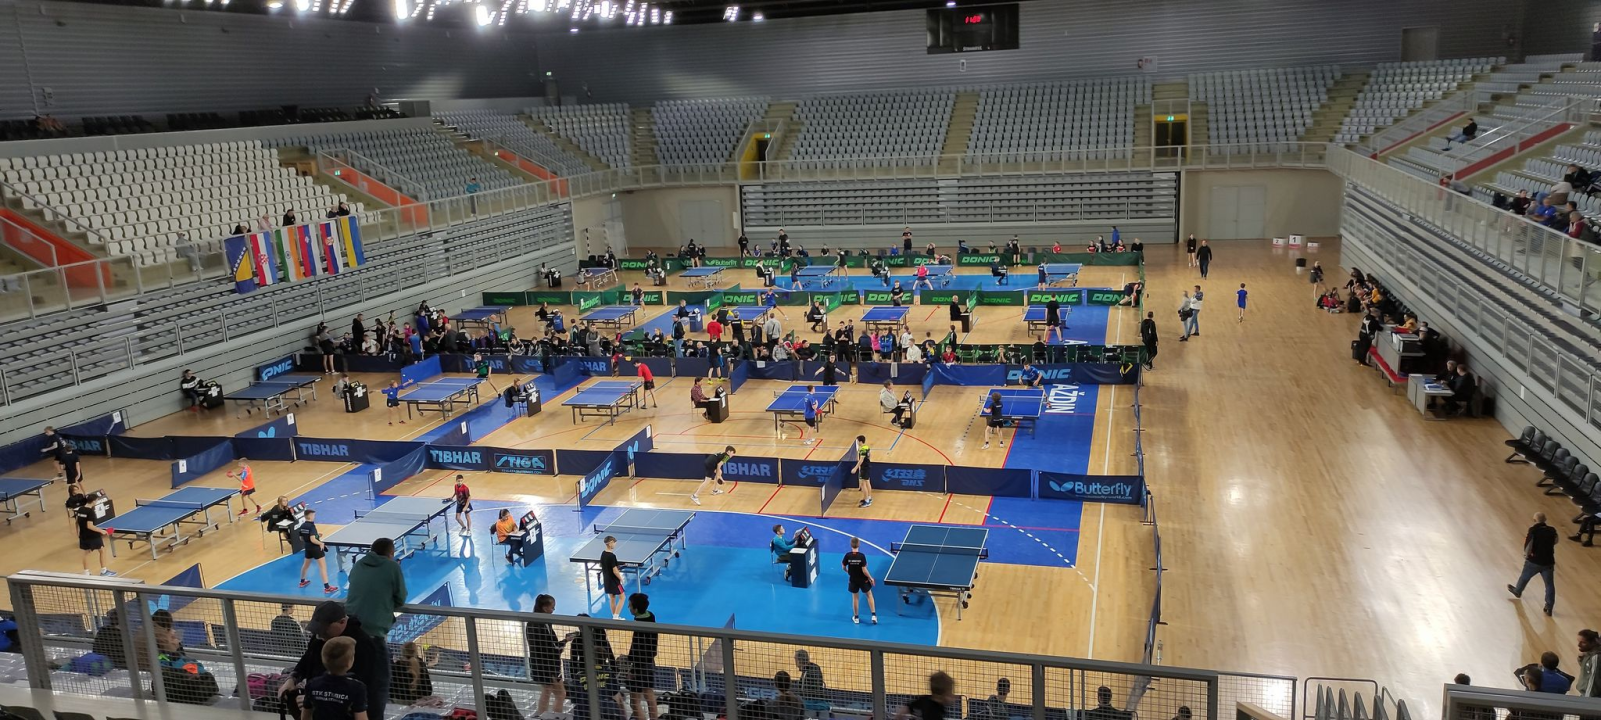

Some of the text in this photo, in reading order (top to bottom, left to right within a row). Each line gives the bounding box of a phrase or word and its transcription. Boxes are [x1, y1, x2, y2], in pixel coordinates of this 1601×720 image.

[300, 443, 348, 456] TIBHAR
[430, 450, 482, 464] TIBHAR
[496, 456, 544, 468] STIGA
[722, 462, 771, 476] IBHAR
[1075, 482, 1132, 496] Butterfly
